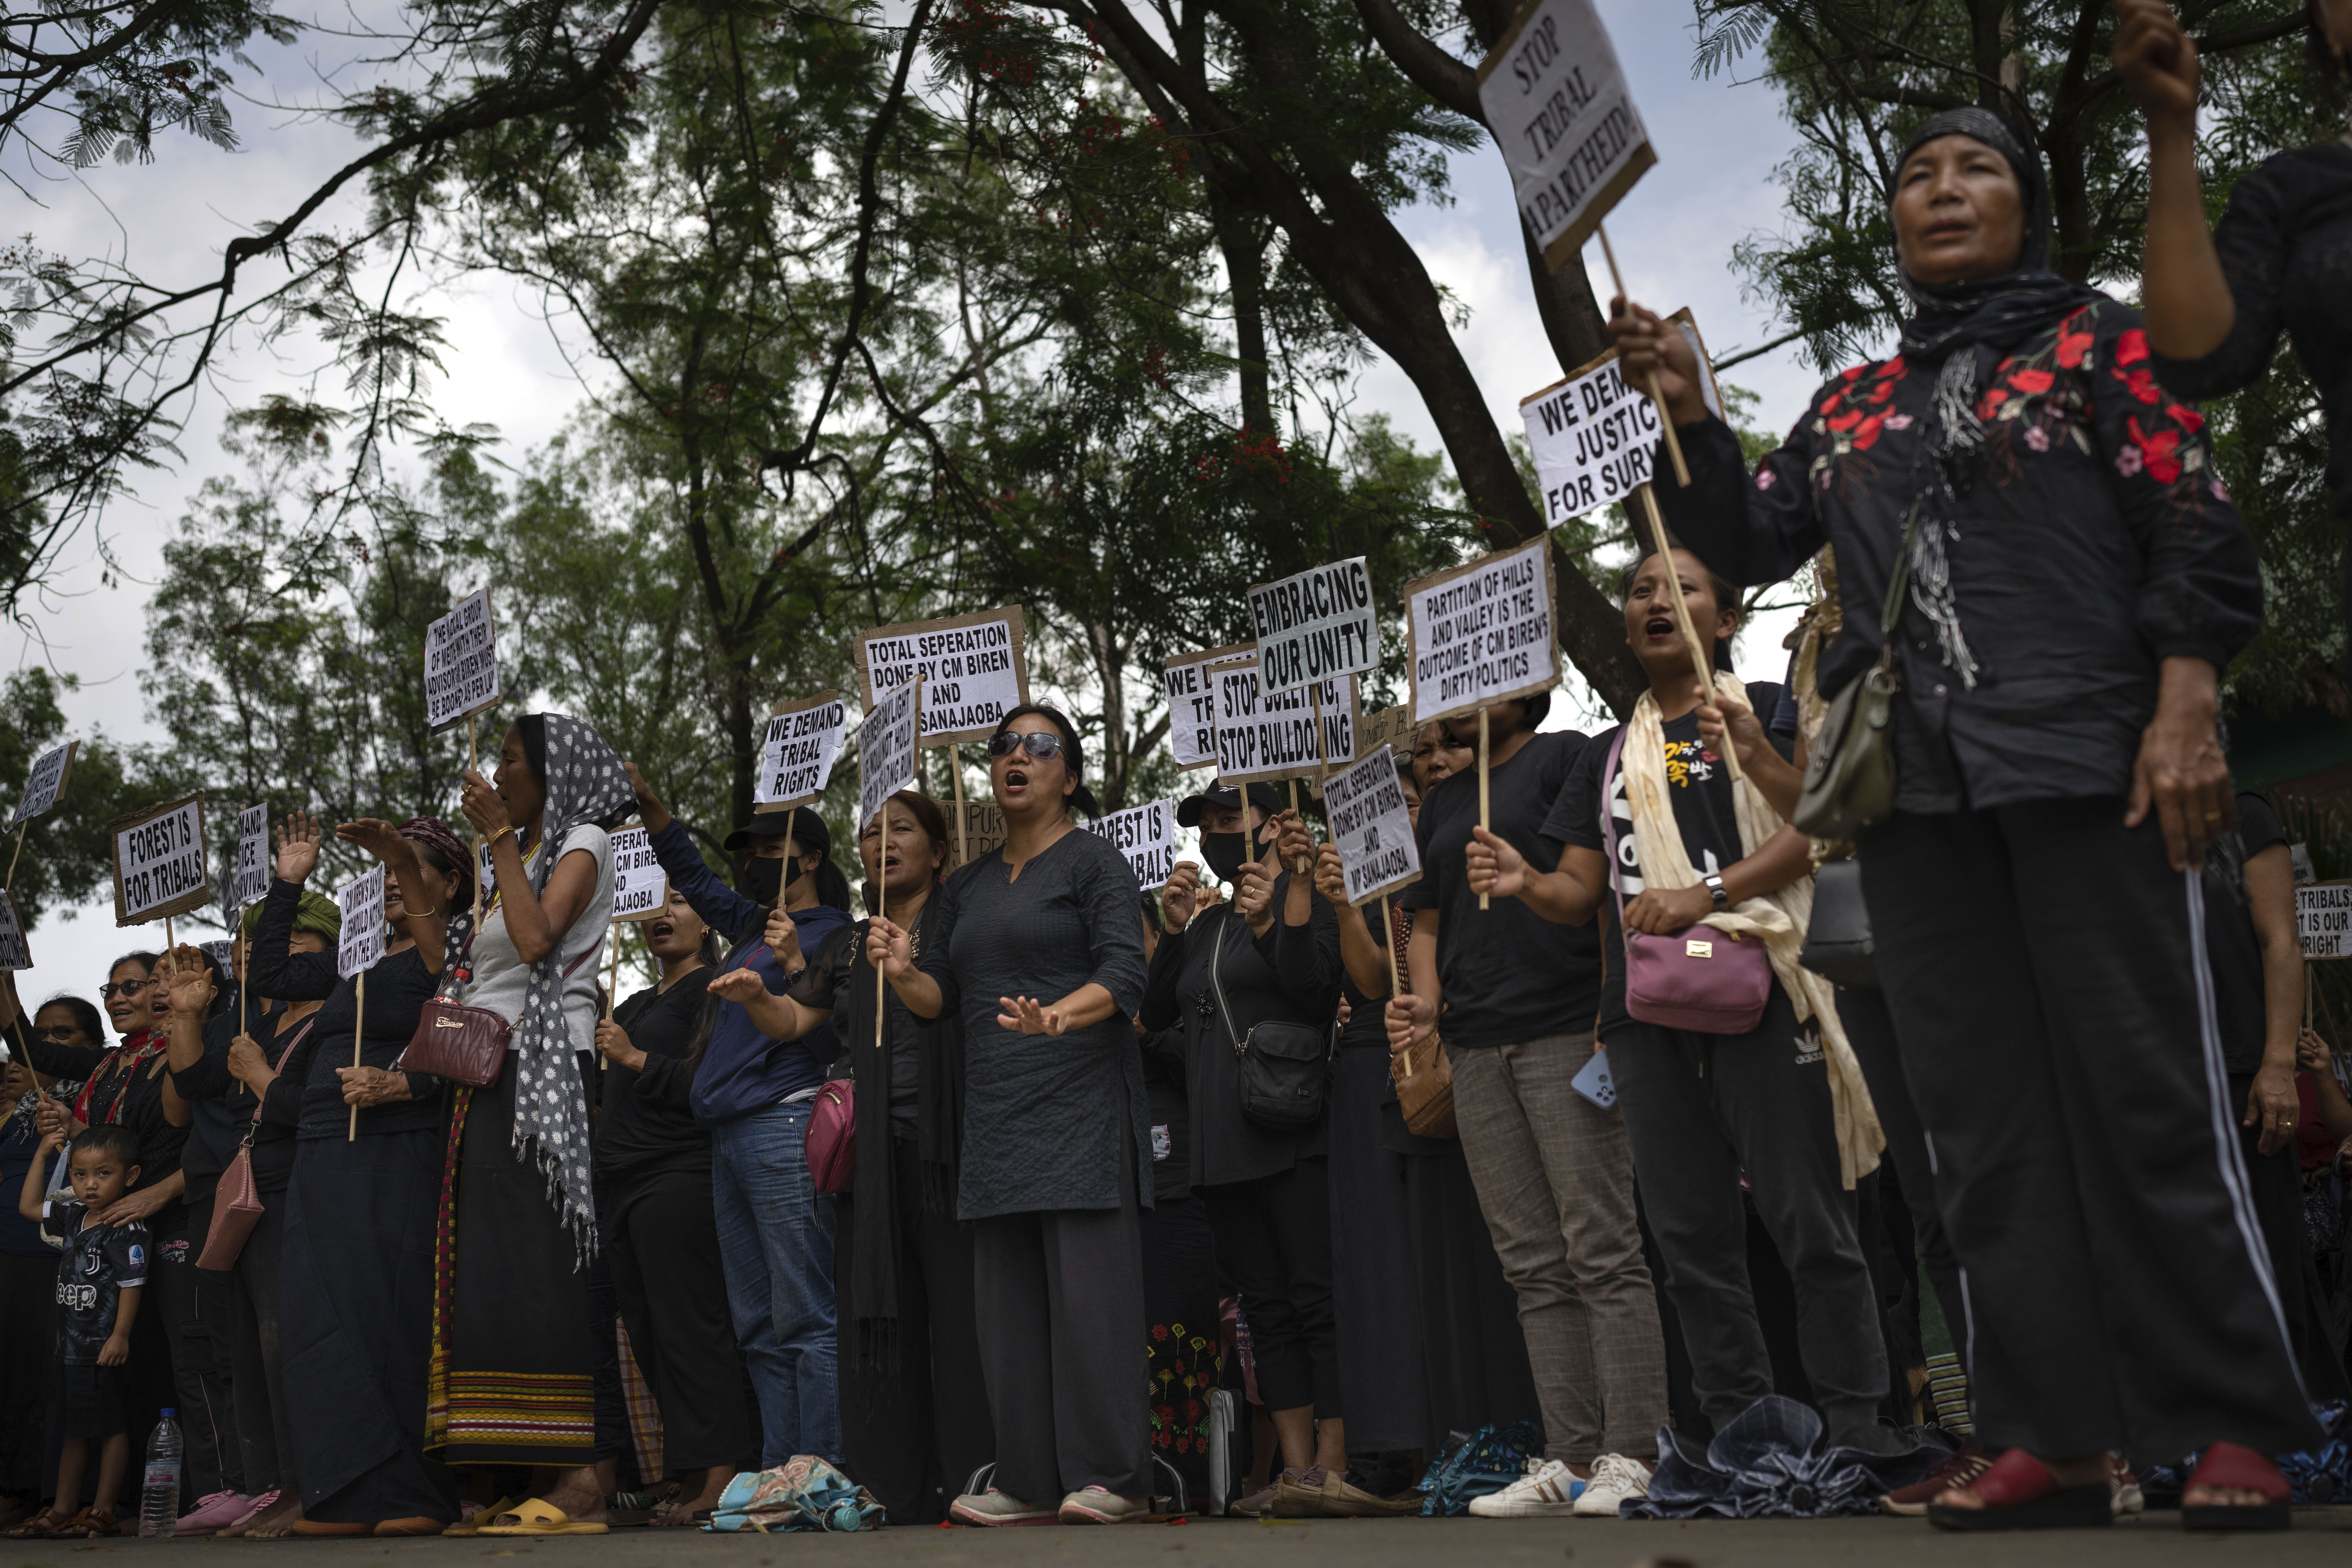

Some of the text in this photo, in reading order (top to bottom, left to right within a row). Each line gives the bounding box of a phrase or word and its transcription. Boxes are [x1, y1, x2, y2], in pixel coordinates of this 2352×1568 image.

[1512, 14, 1561, 96] STOP
[1523, 64, 1597, 162] TRIBAL
[1538, 367, 1633, 436] WE DEM
[1575, 396, 1656, 466] JUSTIC
[1548, 438, 1662, 520] FOR SURV
[1251, 563, 1367, 638] EMBRACING
[1427, 558, 1533, 621] PARTITION OF HILLS
[434, 624, 446, 647] THE
[464, 599, 481, 627] GROUP
[1432, 589, 1534, 649] AND VALLEY IS THE
[431, 650, 440, 671] OF
[455, 634, 470, 657] WITH
[470, 622, 487, 650] THEIR
[461, 653, 479, 679] BIREN
[479, 643, 495, 670] MUST
[869, 624, 1007, 664] TOTAL SEPERATION
[1265, 639, 1303, 690] OUR
[1305, 619, 1367, 677] UNITY
[1419, 642, 1468, 682] OUTCOME
[1472, 636, 1482, 661] OF
[1487, 630, 1504, 655] CM
[874, 649, 1009, 688] DONE BY CM BIREN
[1166, 667, 1197, 697] WE
[1441, 652, 1528, 701] DIRTY POLITICS
[432, 698, 439, 720] BE
[463, 682, 471, 704] AS
[472, 675, 485, 700] PER
[882, 688, 910, 731] DAYLIGHT
[933, 682, 960, 706] AND
[1223, 673, 1258, 718] STOP
[770, 704, 844, 742] WE DEMAND
[921, 701, 1005, 732] SANAJAOBA
[780, 737, 820, 768] TRIBAL
[882, 730, 893, 761] NOT
[895, 720, 911, 753] HOLD
[1220, 726, 1255, 771] STOP
[773, 764, 819, 796] RIGHTS
[900, 749, 913, 780] RUN
[1325, 750, 1394, 810] TOTAL SEPERATION
[944, 805, 1003, 835] ANIPUR
[1148, 806, 1161, 842] IS
[1333, 781, 1403, 839] DONE BY CM BIREN
[129, 811, 191, 866] FOREST IS
[611, 830, 650, 853] EPERAT
[1364, 826, 1380, 856] AND
[125, 871, 152, 911] FOR
[152, 849, 202, 900] TRIBALS
[617, 849, 656, 872] CM BIRE
[1131, 845, 1173, 887] IBALS
[1351, 846, 1410, 895] MP SANAJAOBA
[613, 890, 652, 913] AJAOBA
[615, 875, 626, 892] ND
[369, 903, 378, 931] NOT
[2309, 913, 2320, 931] IS
[2324, 912, 2348, 931] OUR
[352, 942, 358, 967] IN
[358, 937, 370, 964] THE
[57, 1283, 96, 1310] eep
